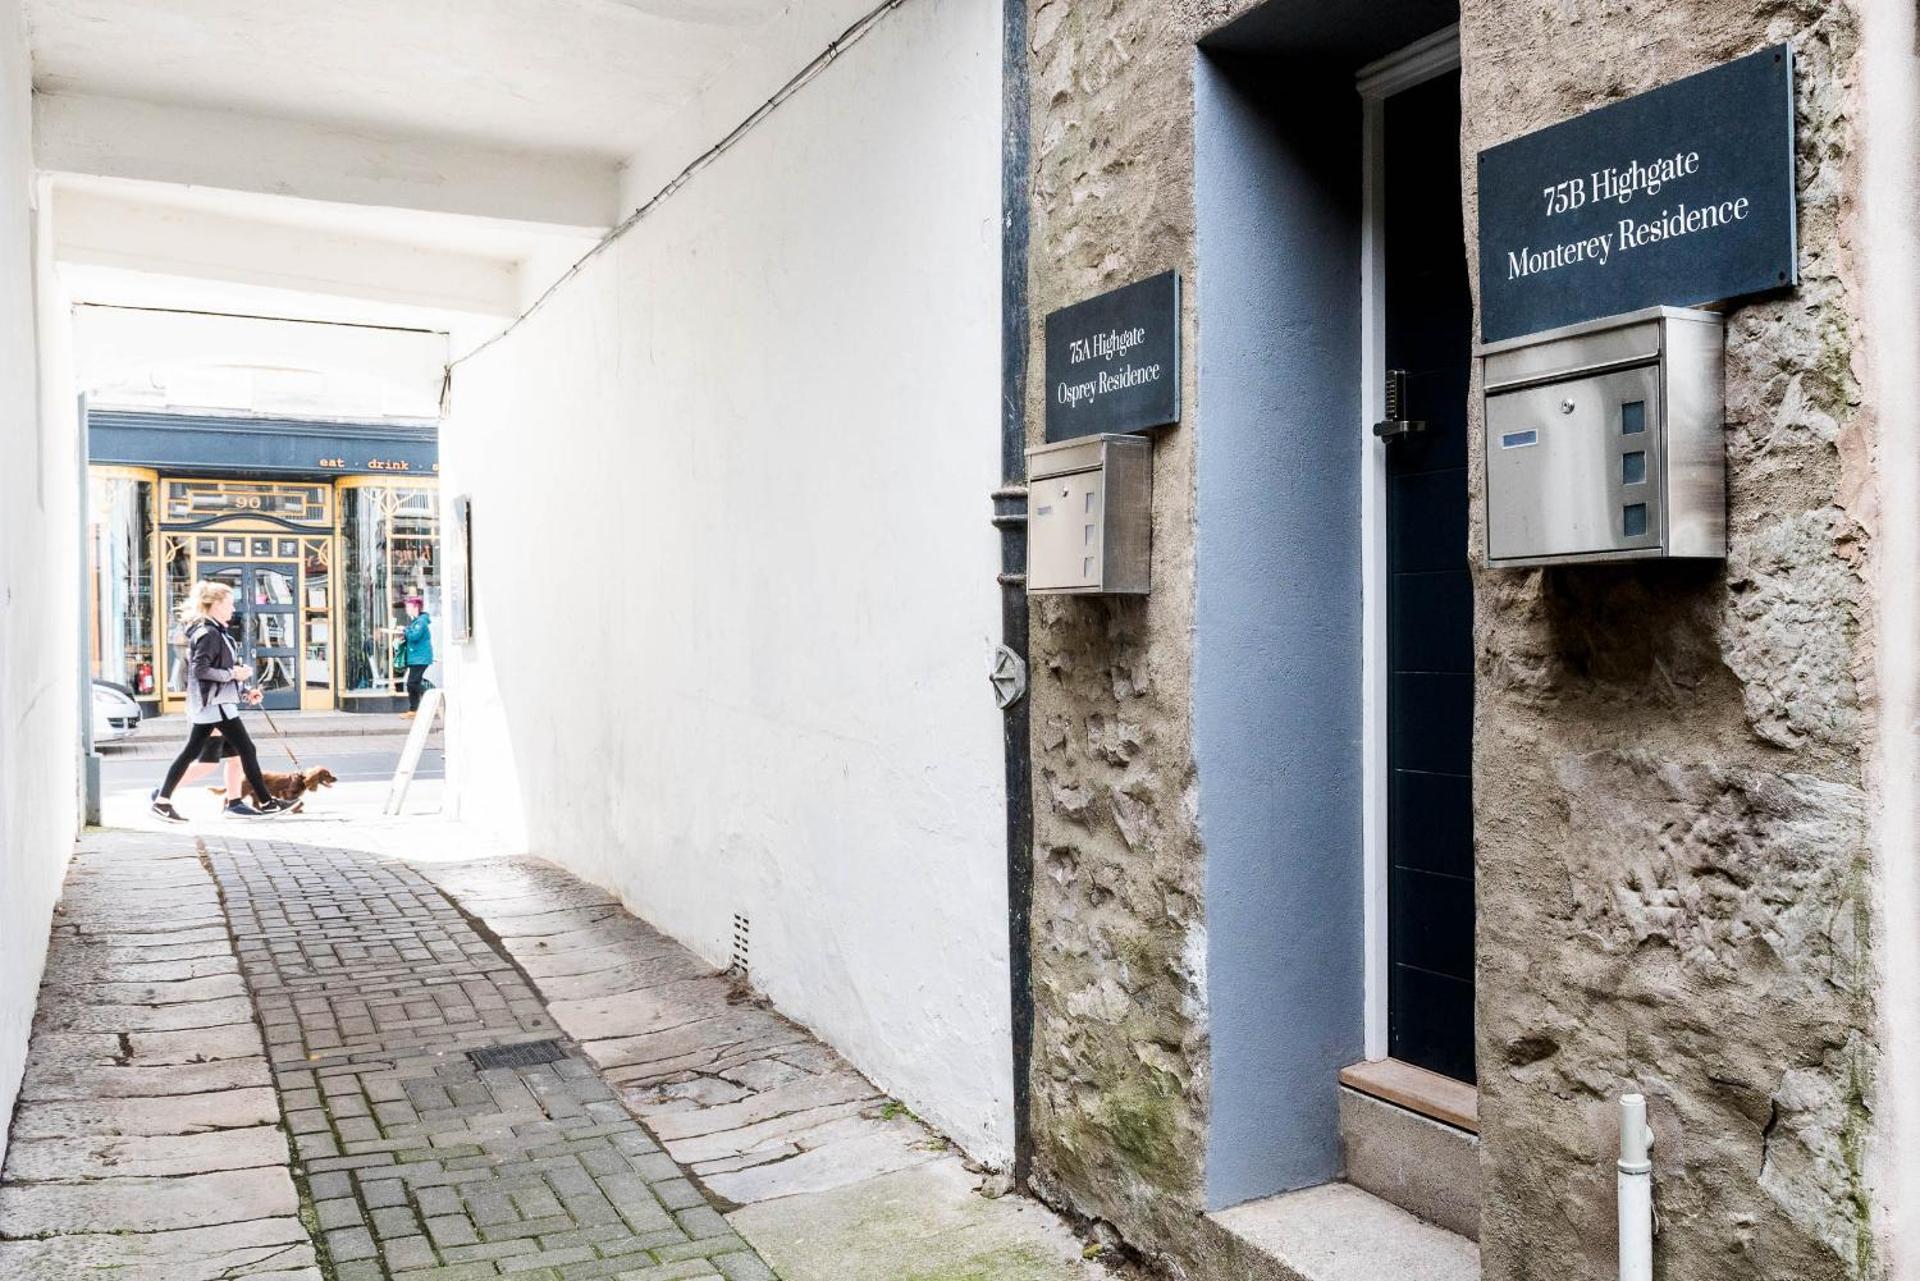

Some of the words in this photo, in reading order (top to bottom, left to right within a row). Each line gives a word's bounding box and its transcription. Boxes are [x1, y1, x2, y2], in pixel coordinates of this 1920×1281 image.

[1543, 179, 1586, 216] 75B
[1591, 152, 1700, 204] Highgate
[1507, 232, 1613, 280] Monterey
[1618, 197, 1750, 251] Residence
[1070, 338, 1091, 364] 75A
[1093, 327, 1145, 360] Highgate
[1058, 380, 1097, 408] Osprey
[1098, 363, 1160, 394] Residence
[319, 458, 344, 468] eat
[367, 458, 409, 470] drink
[235, 496, 261, 509] 90
